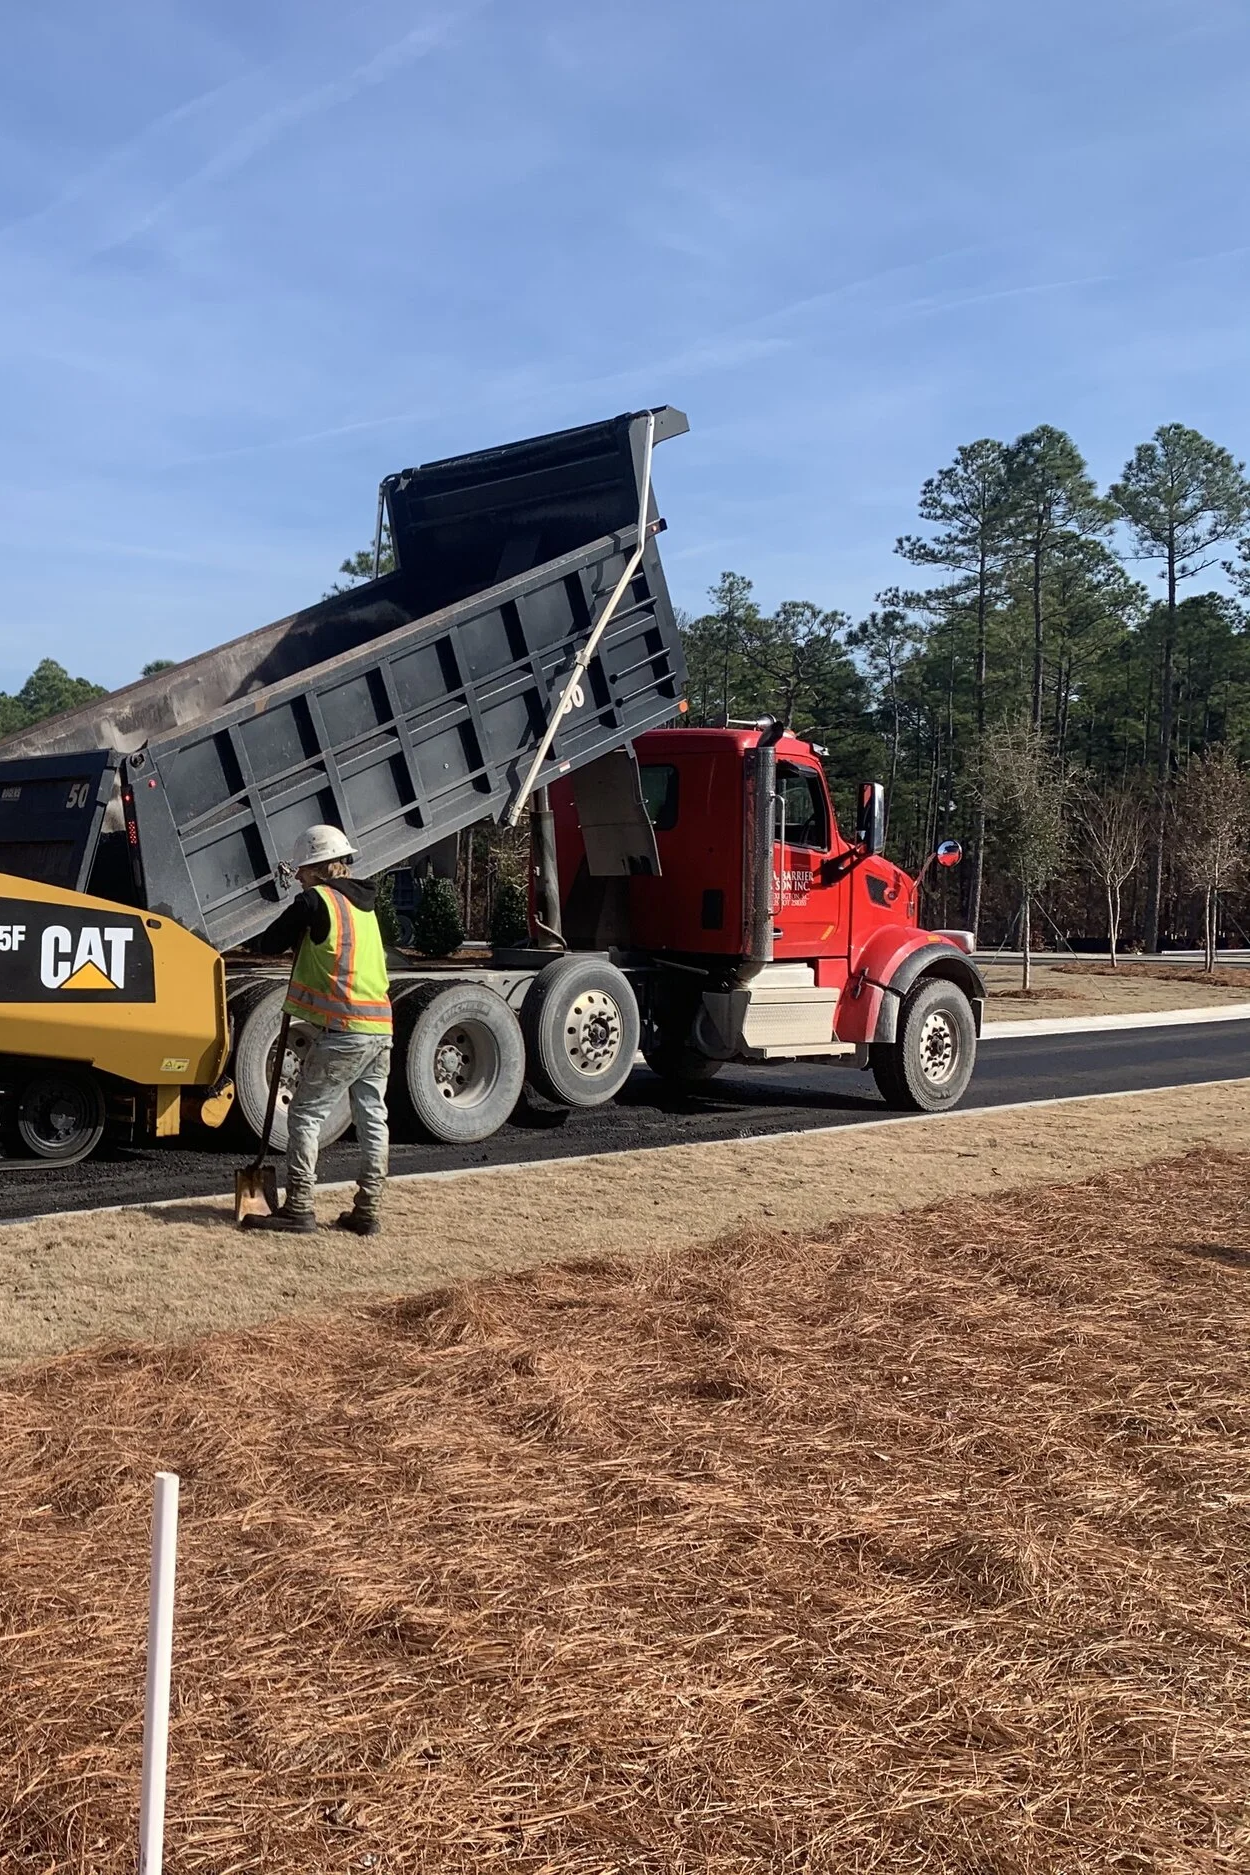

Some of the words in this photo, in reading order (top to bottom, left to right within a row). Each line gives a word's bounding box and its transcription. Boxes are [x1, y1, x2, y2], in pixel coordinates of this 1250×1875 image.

[66, 783, 89, 809] 50
[775, 880, 792, 891] SON
[782, 870, 814, 882] BARRIER
[40, 925, 134, 990] CAT
